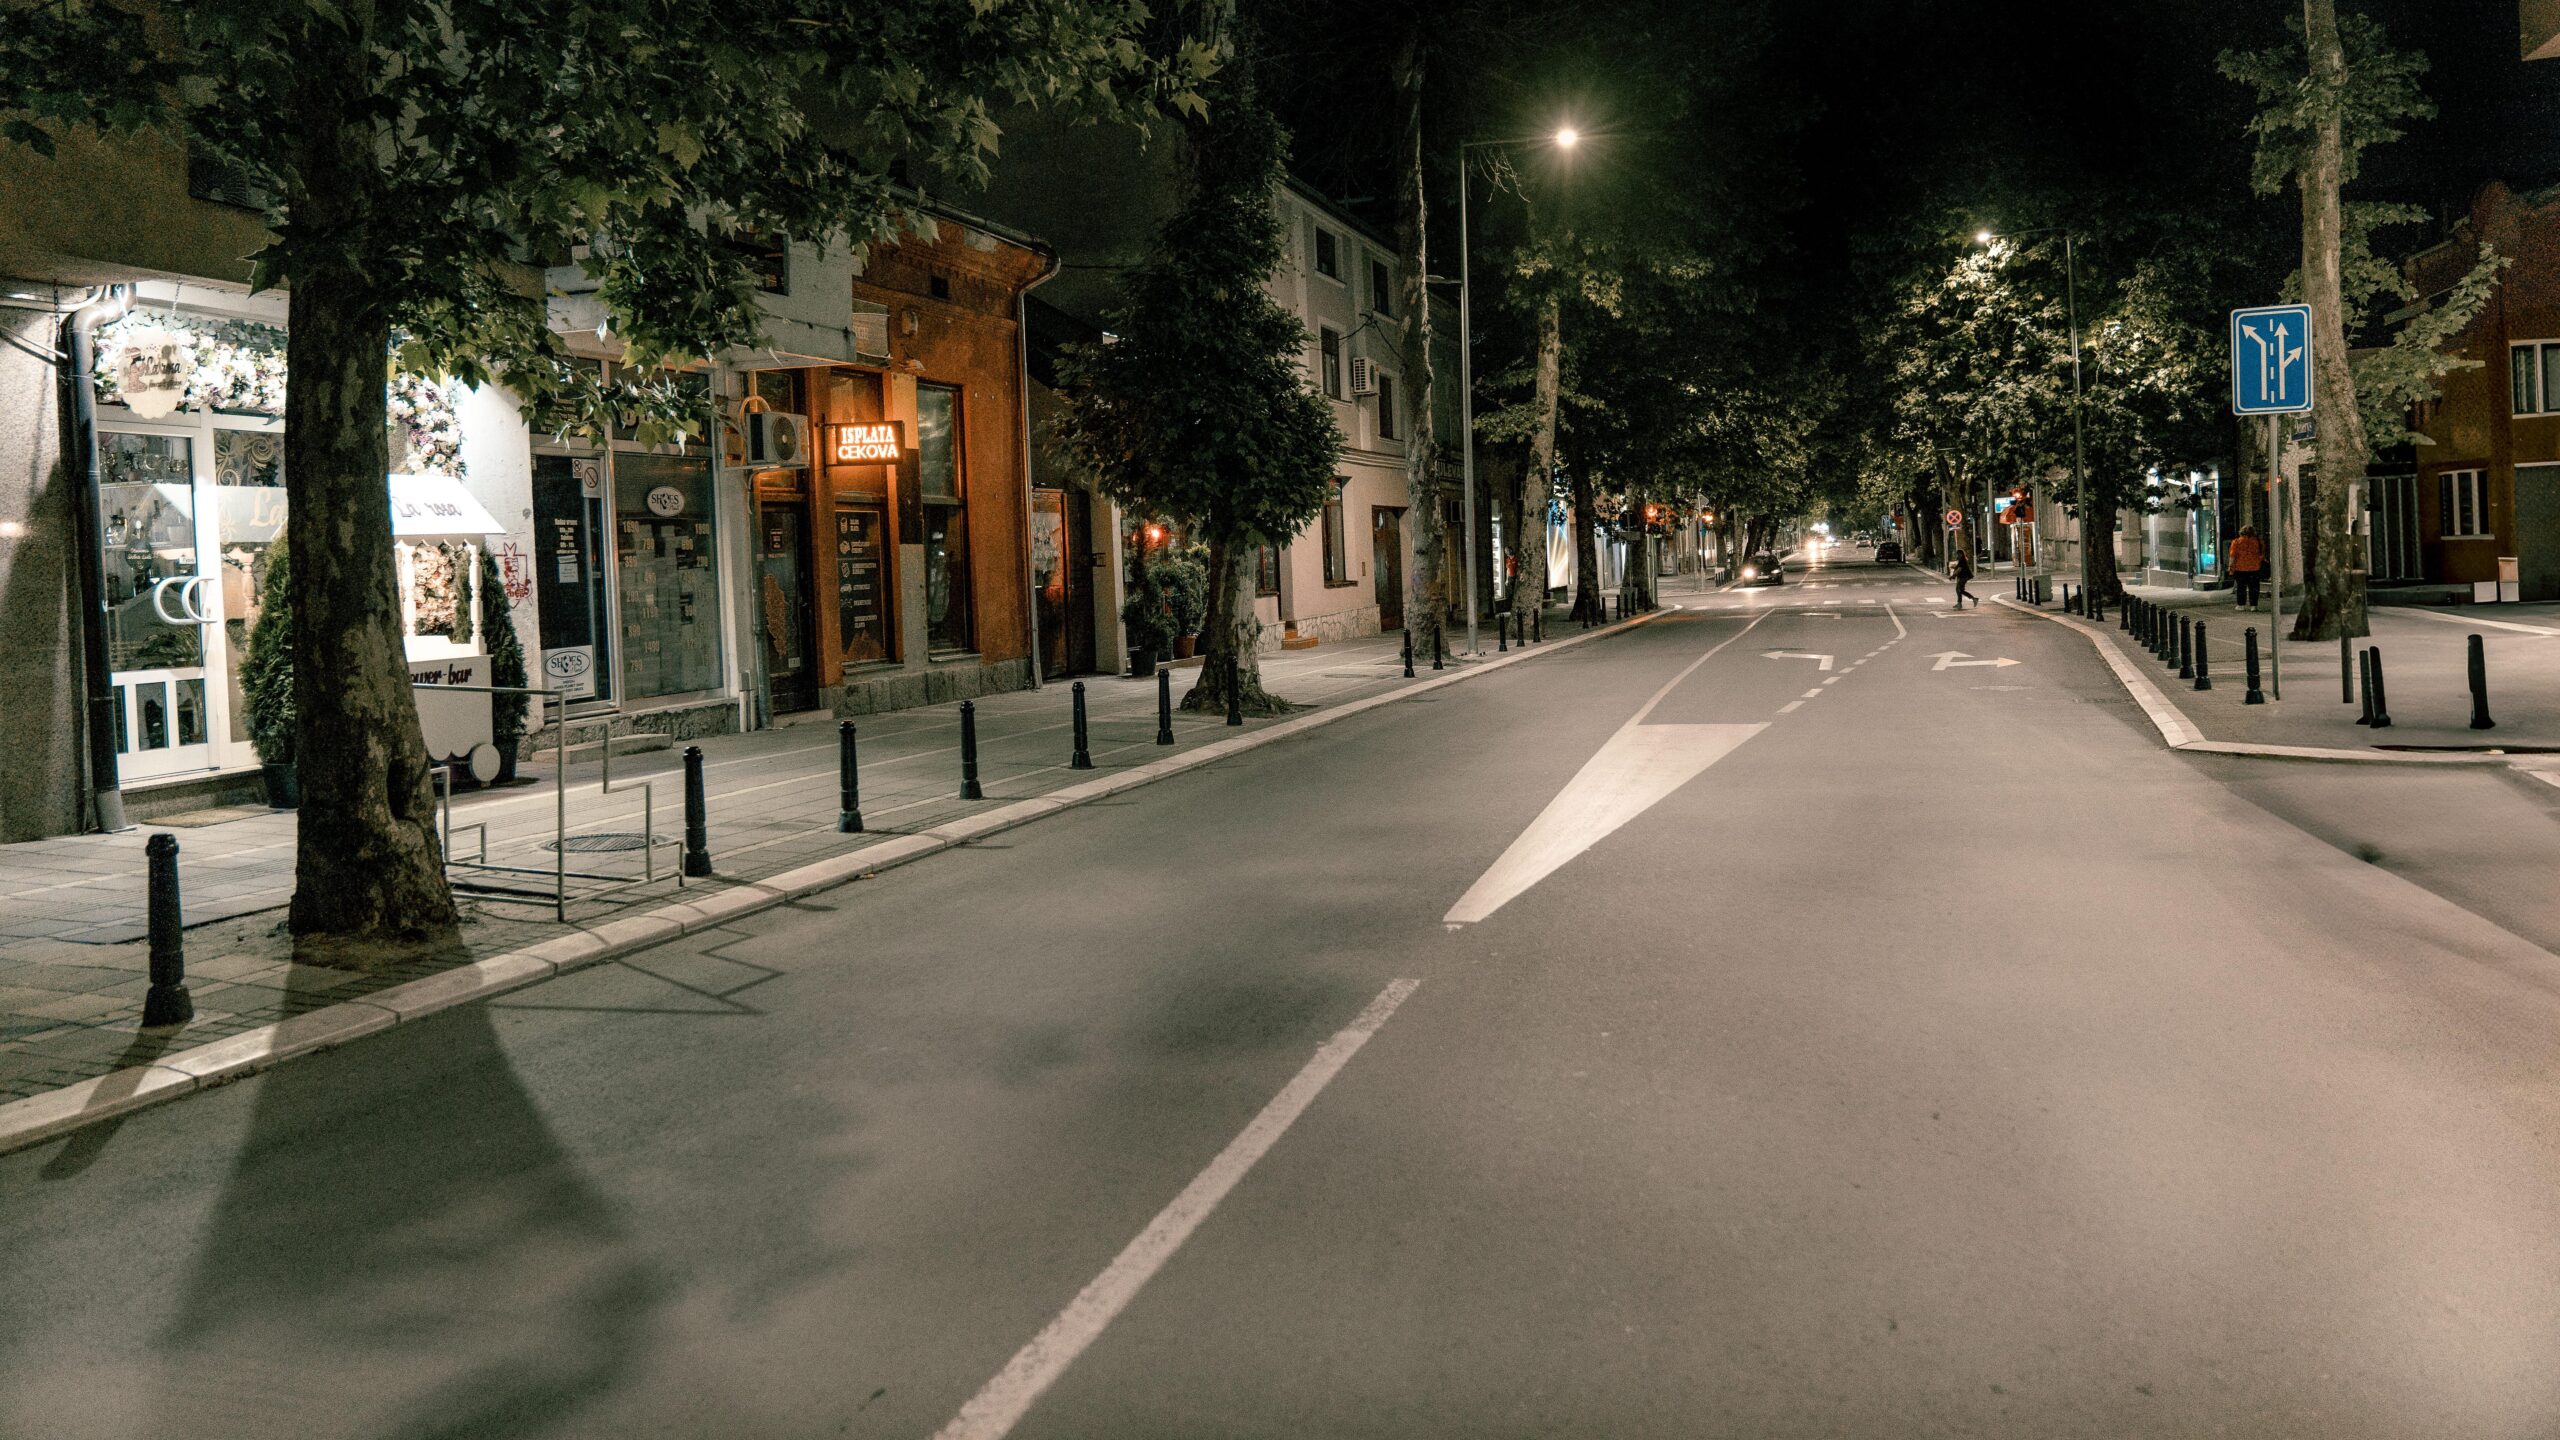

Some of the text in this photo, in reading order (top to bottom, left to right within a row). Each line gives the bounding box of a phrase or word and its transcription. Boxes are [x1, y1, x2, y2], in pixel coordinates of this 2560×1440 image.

[841, 425, 895, 444] ISPLATA
[838, 443, 899, 459] CEKOVA
[424, 502, 462, 516] rosa
